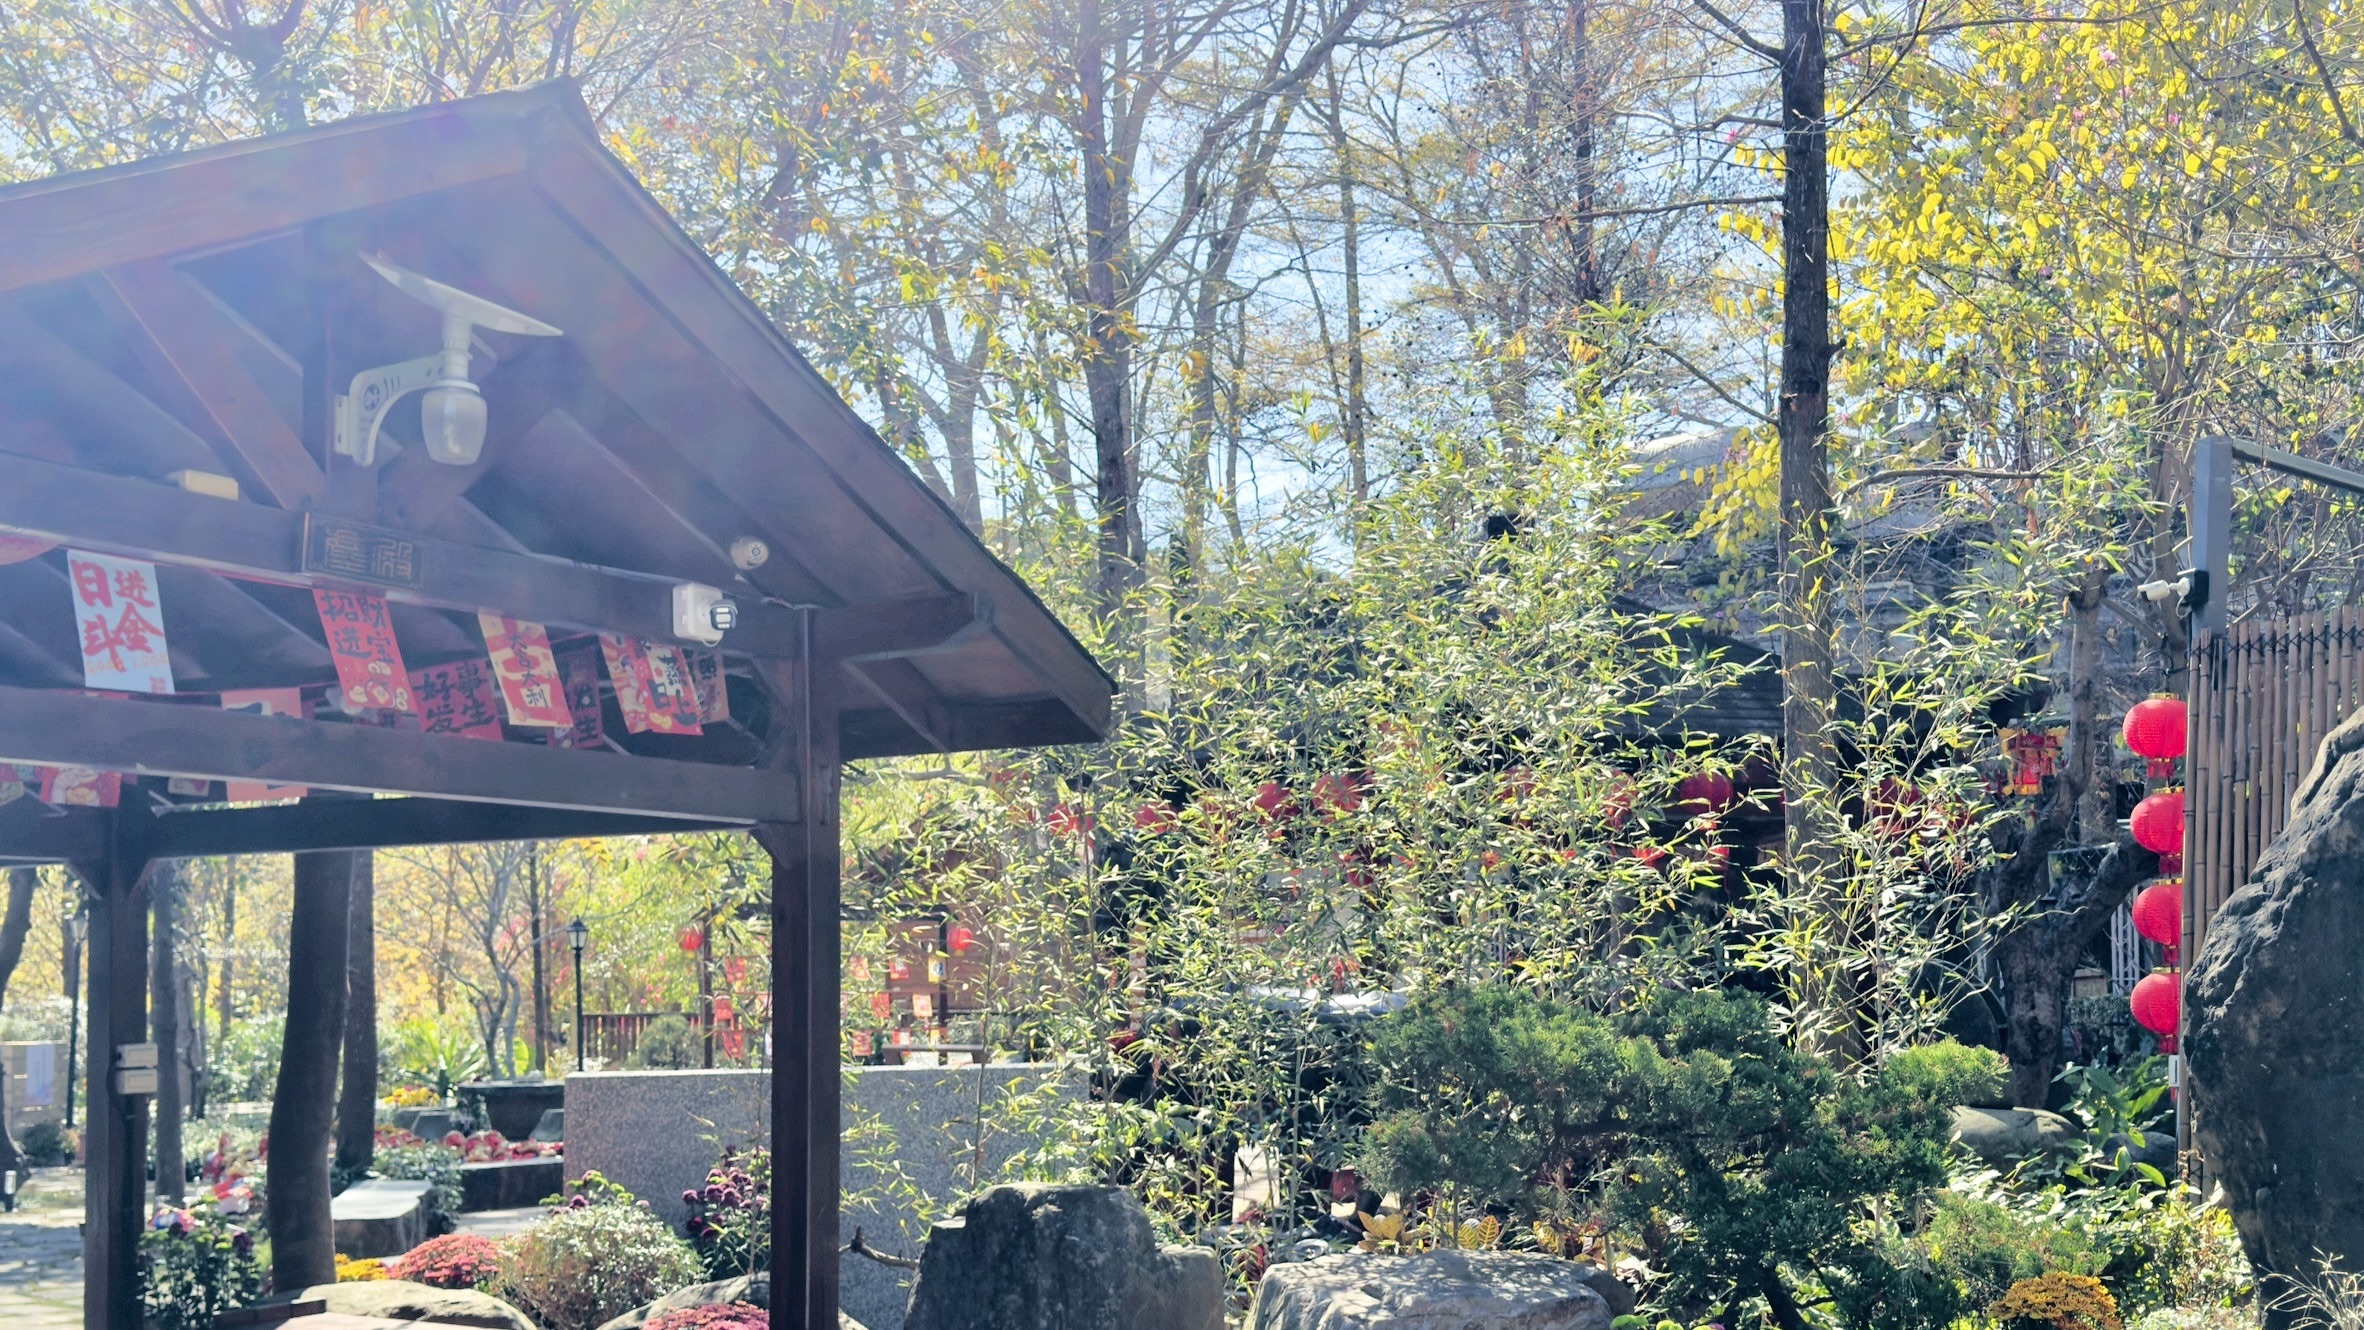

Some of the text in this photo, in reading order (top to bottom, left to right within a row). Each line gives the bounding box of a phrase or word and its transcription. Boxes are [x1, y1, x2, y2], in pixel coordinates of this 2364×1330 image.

[83, 601, 165, 672] 斗金
[509, 632, 549, 709] 大吉大利
